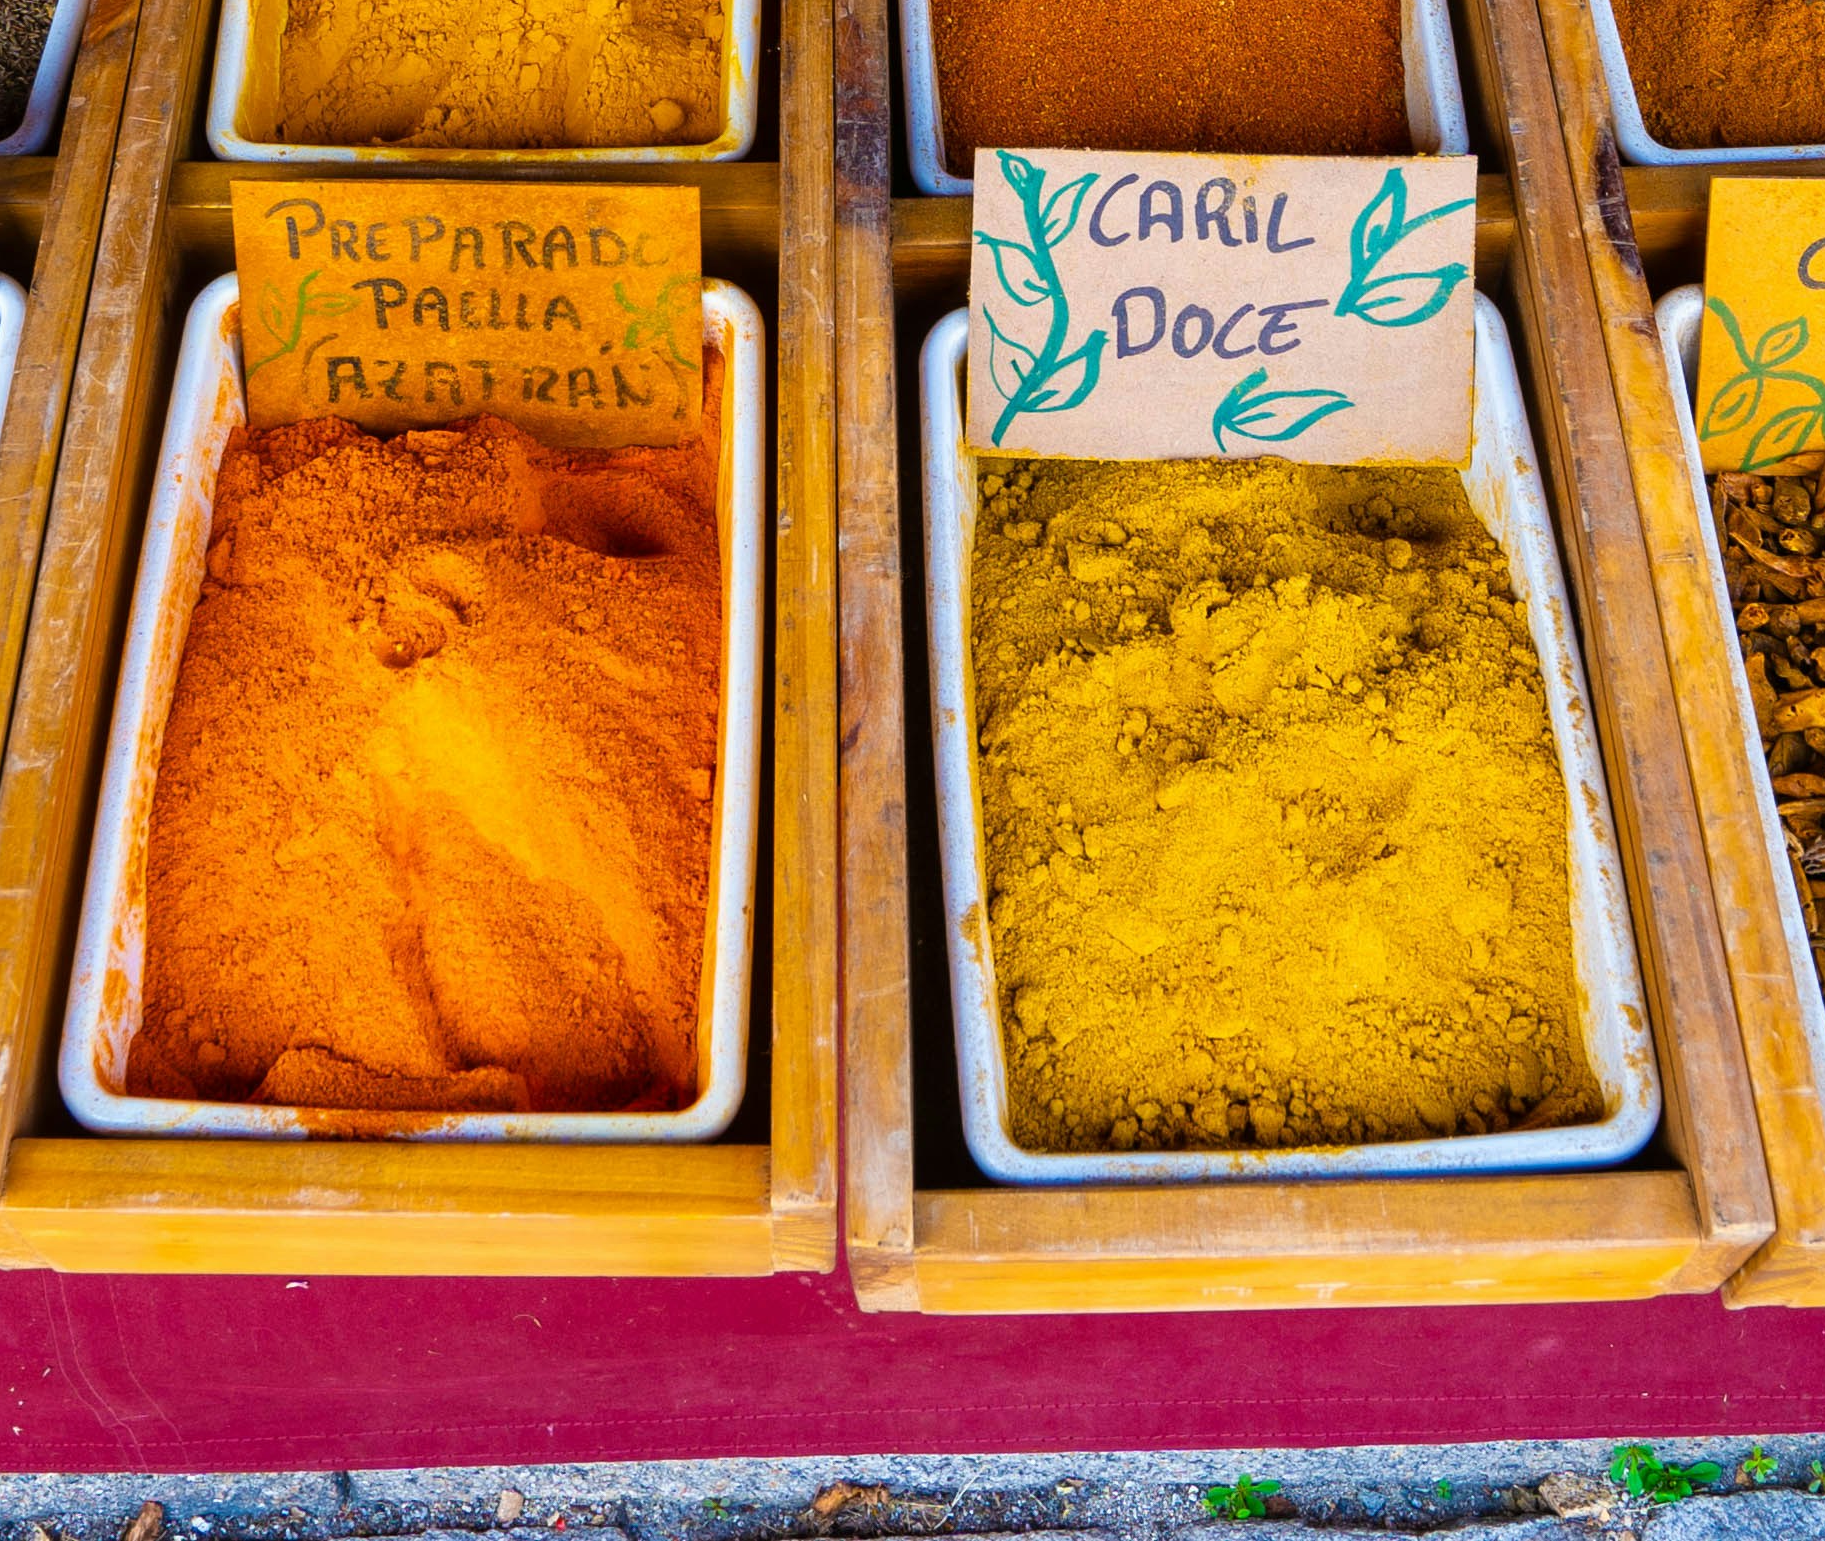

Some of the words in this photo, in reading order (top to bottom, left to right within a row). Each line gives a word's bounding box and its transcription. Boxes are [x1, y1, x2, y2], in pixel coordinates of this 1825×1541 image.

[1088, 172, 1316, 255] CARIL
[352, 277, 582, 332] PAELLA
[1110, 285, 1330, 362] DOCE
